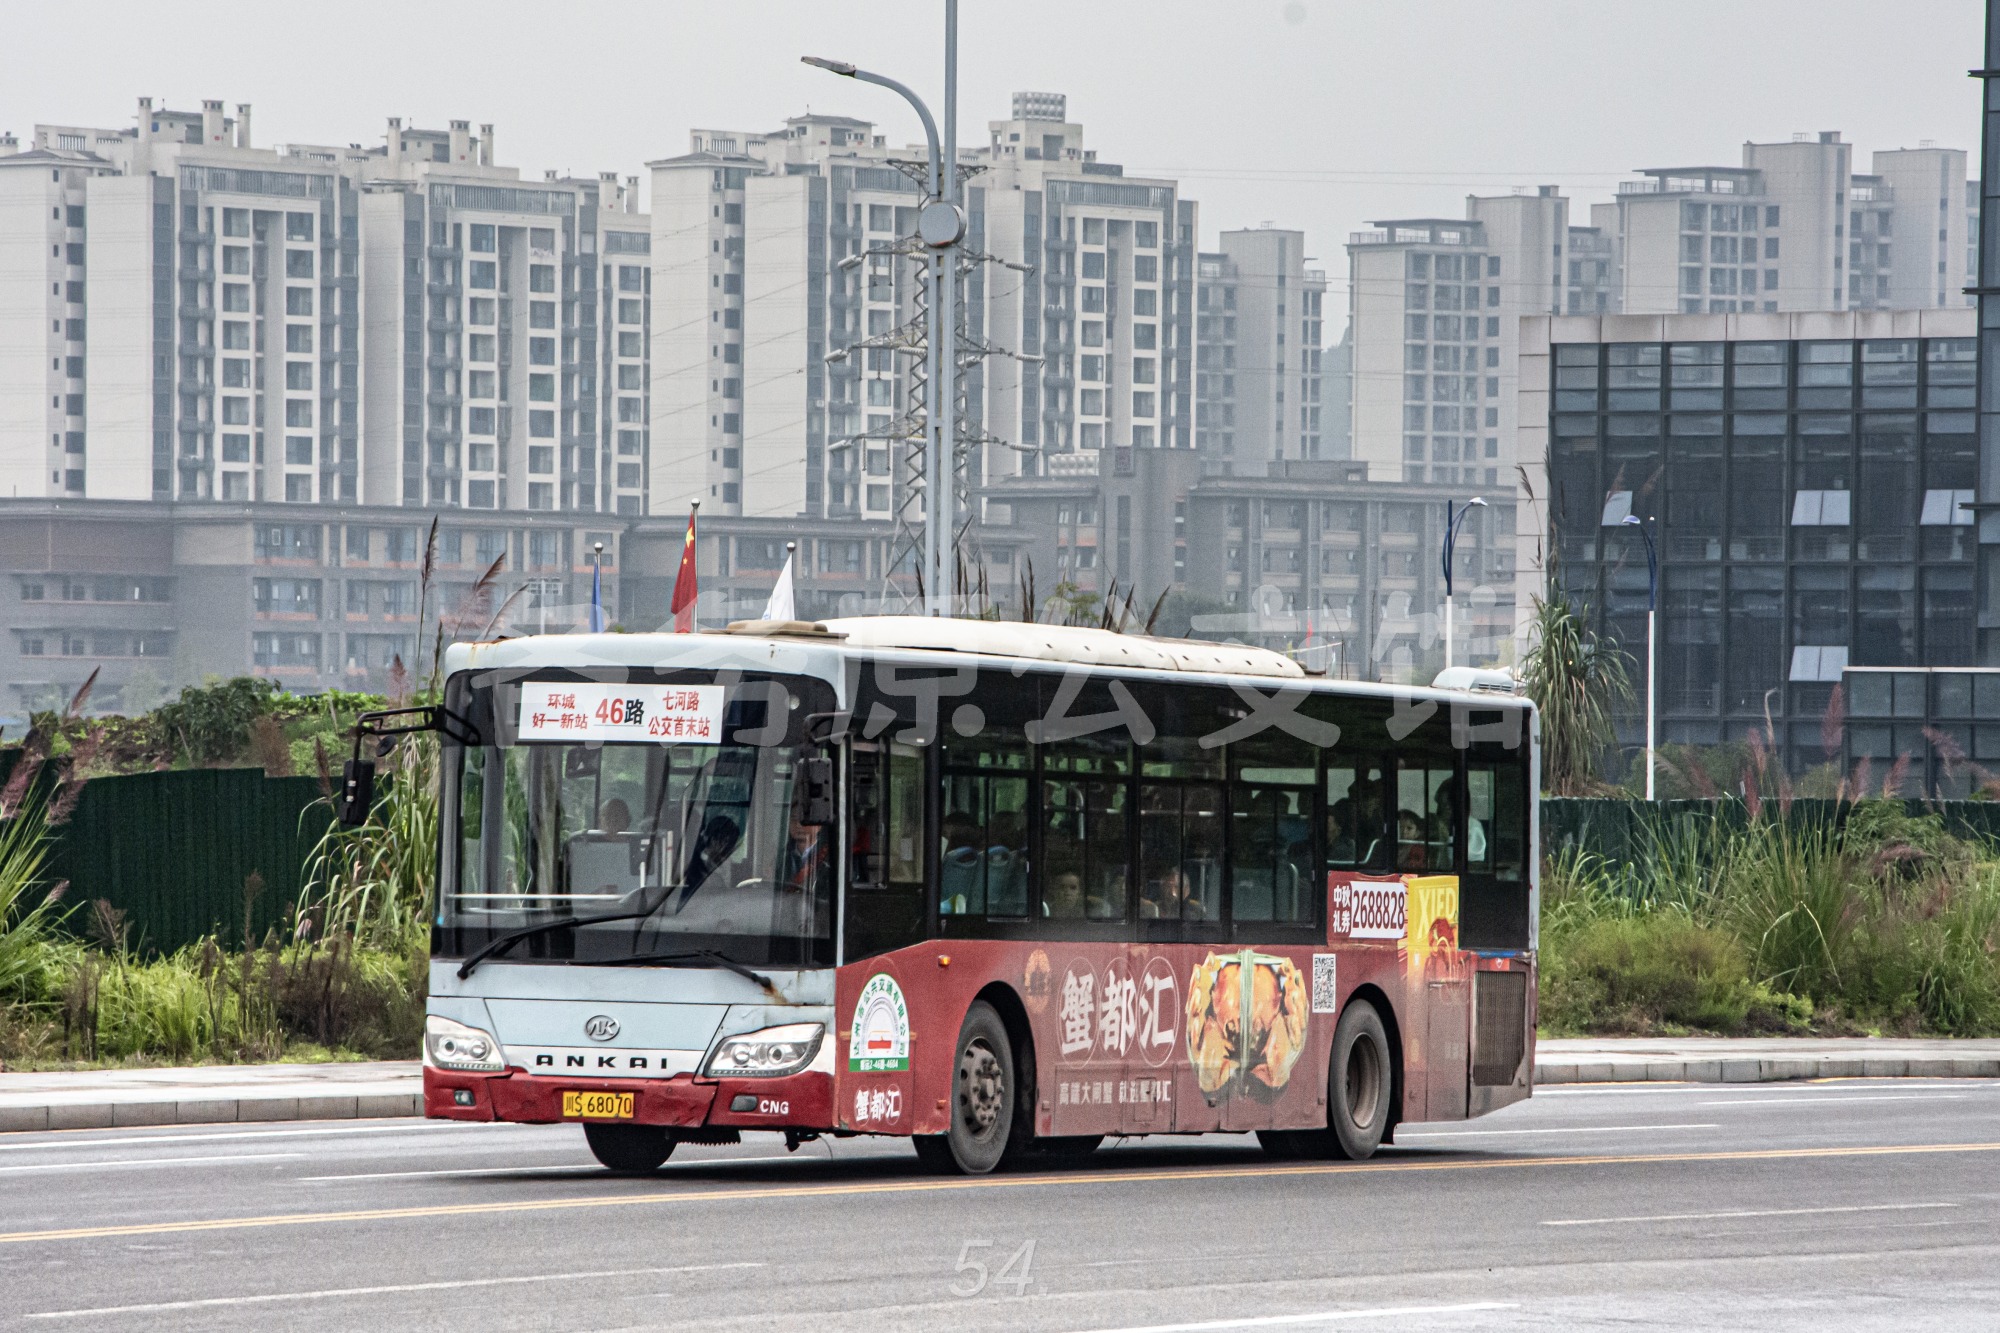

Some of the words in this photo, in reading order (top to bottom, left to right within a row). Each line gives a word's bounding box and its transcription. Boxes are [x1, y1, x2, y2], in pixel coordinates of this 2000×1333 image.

[547, 693, 576, 710] 环城
[595, 698, 645, 725] 46路
[662, 691, 700, 711] 七河路
[532, 713, 588, 730] 好一新站
[648, 716, 711, 737] 公交首末站
[1333, 885, 1351, 908] 中秋
[1352, 890, 1405, 930] 2688828
[1061, 970, 1176, 1058] 蟹都汇
[536, 1054, 667, 1070] ANKAI
[759, 1099, 789, 1114] CNG
[856, 1089, 900, 1122] 蟹都汇
